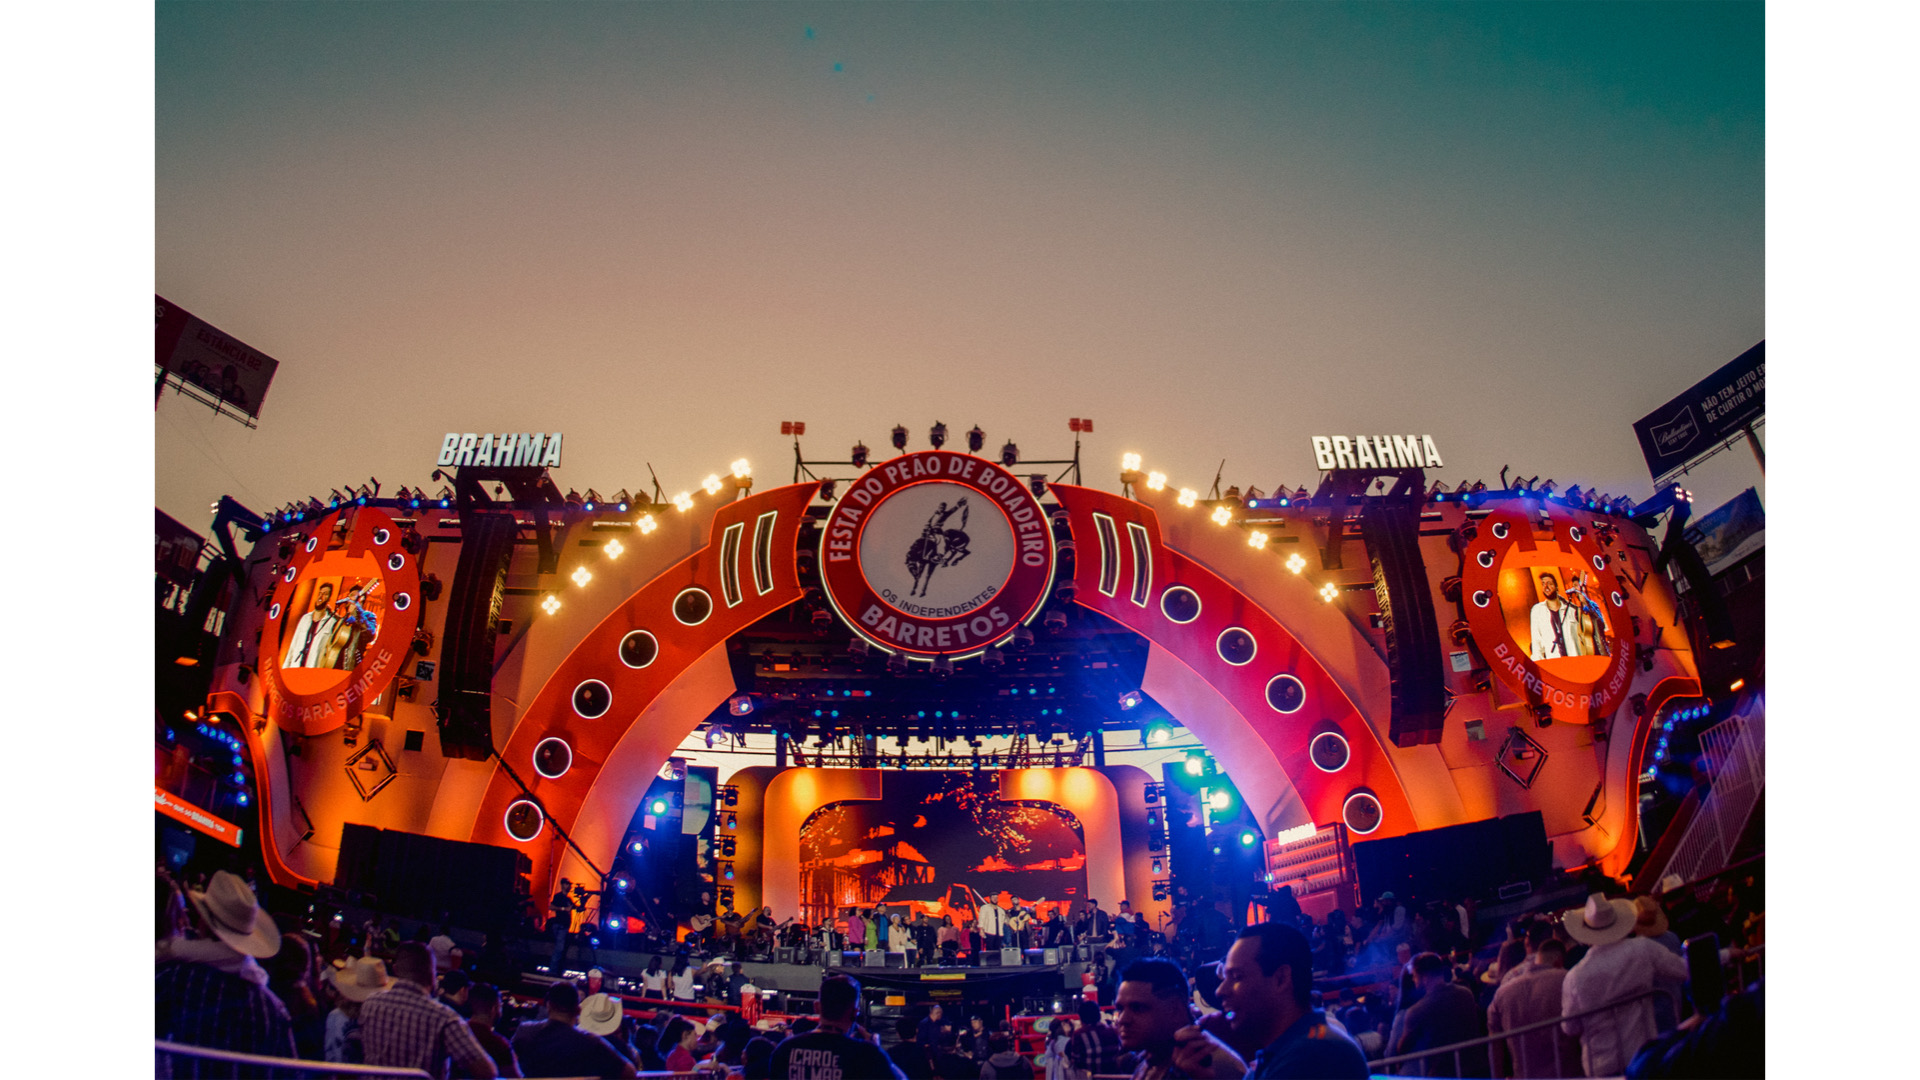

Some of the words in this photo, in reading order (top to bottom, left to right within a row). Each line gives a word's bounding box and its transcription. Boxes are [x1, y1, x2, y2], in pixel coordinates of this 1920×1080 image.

[1701, 395, 1718, 412] NÃO
[1718, 384, 1735, 401] TEM
[1736, 371, 1757, 390] JEITO
[1706, 411, 1718, 423] DE
[1717, 392, 1746, 416] CURTIR
[1745, 387, 1753, 398] O
[437, 432, 563, 467] BRAHMA
[1311, 434, 1443, 470] BRAHMA
[829, 507, 864, 562] FESTA
[852, 476, 884, 506] DO
[885, 453, 941, 484] PEÃO
[948, 456, 977, 479] DE
[977, 468, 1045, 567] BOIADEIRO
[882, 588, 898, 604] OS
[899, 585, 997, 617] INDEPENDENTES
[860, 604, 1010, 647] BARRETOS
[297, 701, 335, 722] PARA
[336, 649, 392, 709] SEMPRE
[1493, 643, 1575, 709] BARRETOS
[1579, 691, 1611, 709] PARA
[1609, 639, 1630, 695] SEMPRE
[789, 1048, 832, 1067] ICARO
